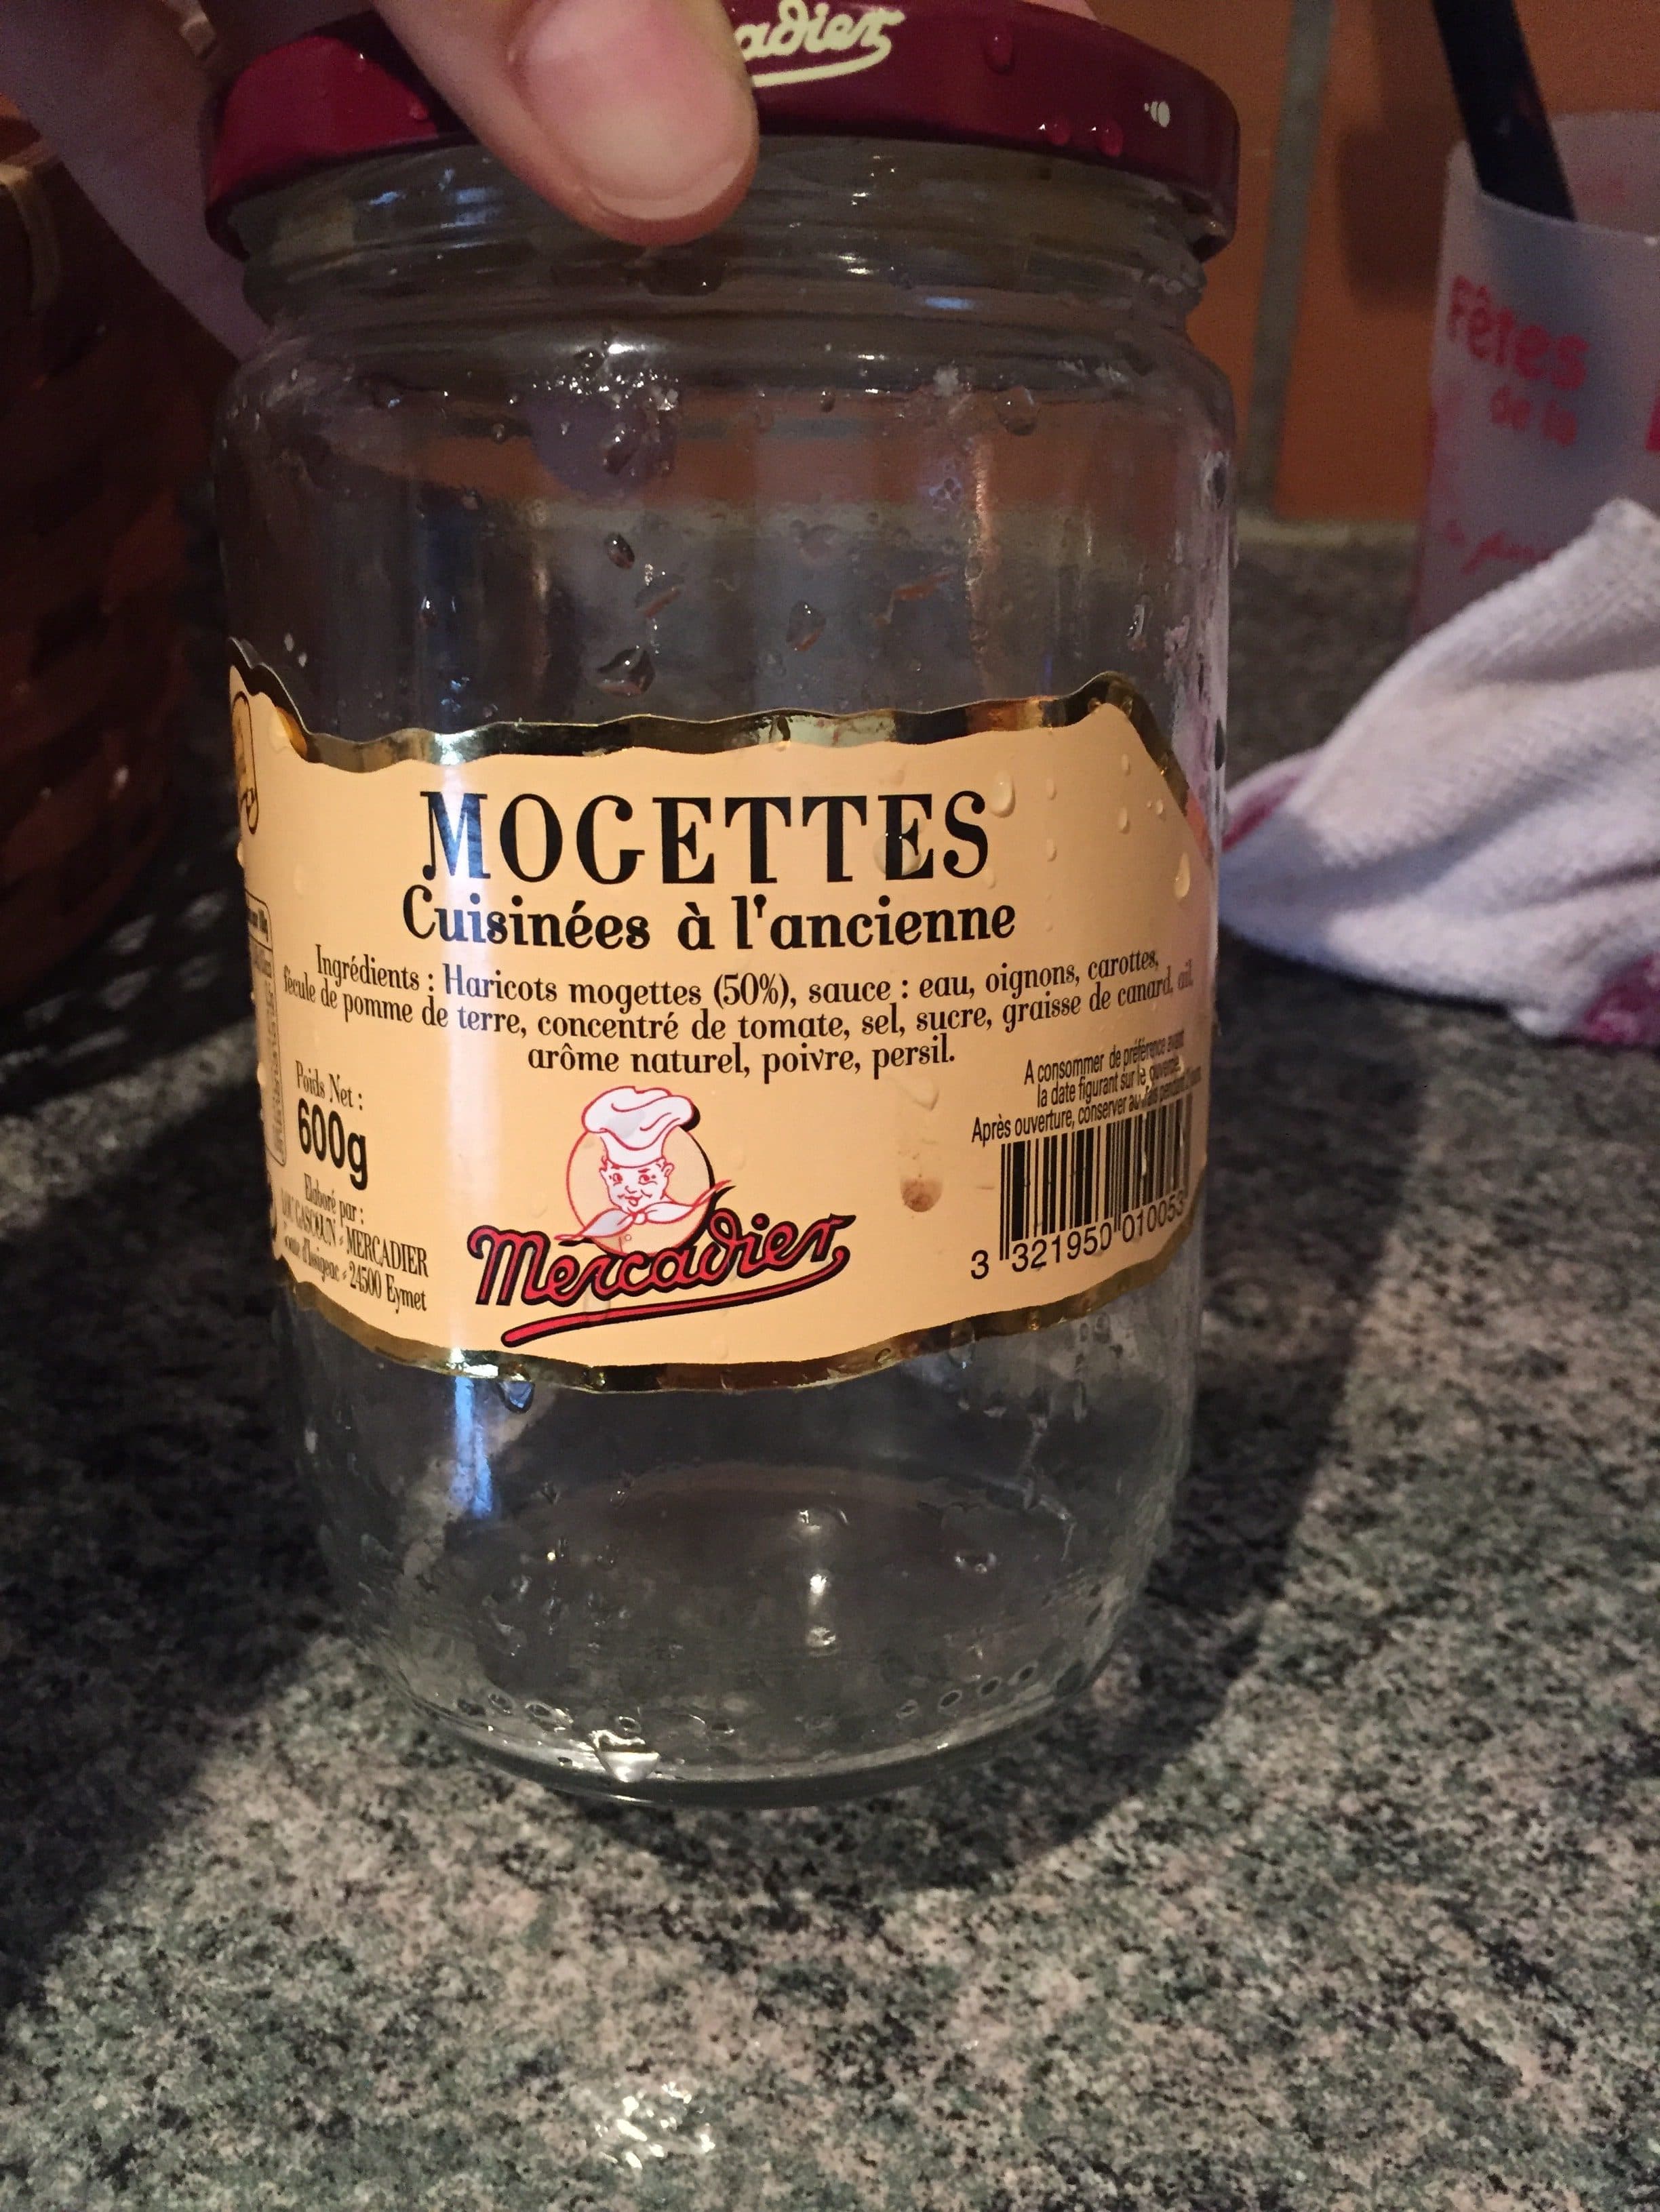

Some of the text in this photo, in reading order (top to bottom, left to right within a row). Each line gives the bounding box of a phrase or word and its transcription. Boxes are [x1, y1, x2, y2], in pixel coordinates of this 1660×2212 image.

[734, 0, 907, 62] adier
[420, 790, 989, 885] MOGETTES
[402, 884, 1016, 950] Cuisinées à l'ancienne
[283, 965, 316, 1003] fécule
[321, 977, 338, 1009] de
[343, 992, 414, 1023] pomme
[422, 994, 448, 1028] de
[457, 1005, 528, 1039] terre,
[537, 1011, 679, 1040] concentré
[691, 1008, 726, 1040] de
[738, 1013, 851, 1041] tomate,
[861, 1003, 906, 1037] sel,
[916, 1006, 993, 1032] sucre,
[1002, 990, 1082, 1033] graisse
[1088, 981, 1111, 1012] de
[315, 944, 420, 991] Ingrédients
[442, 963, 557, 1003] Haricots
[568, 981, 702, 1015] mogettes
[713, 971, 797, 1009] (50%),
[808, 978, 892, 1004] sauce
[919, 976, 976, 1000] eau,
[985, 962, 1080, 1000] oignons,
[1087, 949, 1159, 980] carottes,
[295, 1060, 325, 1100] Poids
[329, 1072, 353, 1108] Net
[528, 1033, 955, 1085] arôme naturel, poivre, persil.
[1024, 1059, 1035, 1085] A
[1038, 1054, 1105, 1083] consommer
[1109, 1045, 1121, 1070] de
[1037, 1083, 1048, 1108] la
[1050, 1081, 1076, 1106] date
[1078, 1072, 1119, 1105] figurant
[1120, 1069, 1135, 1091] sur
[1137, 1063, 1147, 1086] le
[298, 1098, 368, 1191] 600g
[970, 1112, 1012, 1148] Après
[1014, 1108, 1075, 1137] ouverture,
[1078, 1095, 1127, 1125] conserver
[1128, 1093, 1141, 1112] au
[304, 1173, 336, 1215] Elaboré
[339, 1199, 357, 1228] par
[345, 1226, 429, 1278] MERCADIER
[467, 1207, 856, 1308] Mercadier
[970, 1249, 990, 1280] 3
[1011, 1222, 1112, 1273] 321950
[349, 1260, 382, 1300] 24500
[385, 1273, 427, 1314] Eymet
